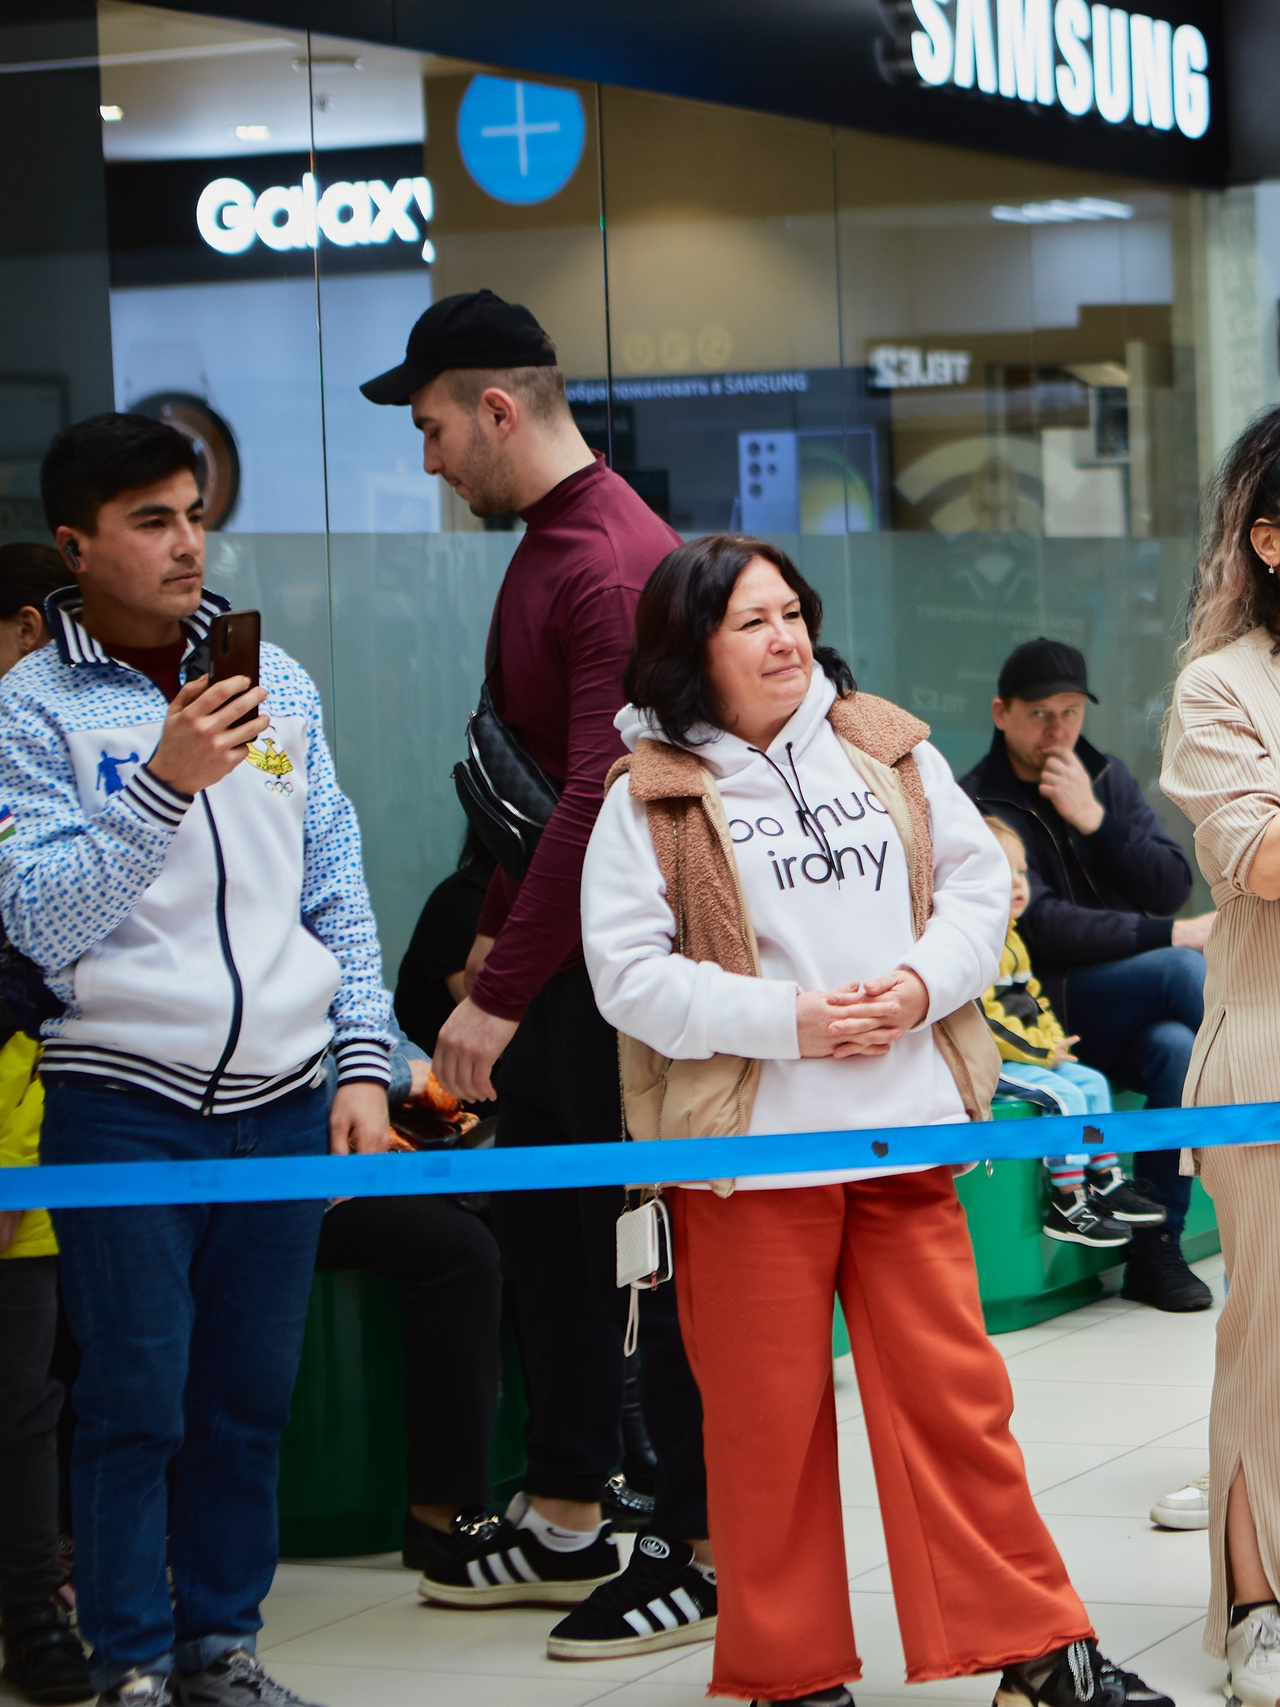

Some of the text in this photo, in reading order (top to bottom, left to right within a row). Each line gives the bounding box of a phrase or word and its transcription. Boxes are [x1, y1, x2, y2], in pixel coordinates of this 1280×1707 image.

[911, 0, 1210, 139] SAMSUNG
[565, 381, 607, 404] обро
[725, 373, 808, 395] SAMSUNG
[729, 791, 889, 843] oo muc
[767, 841, 888, 891] irony
